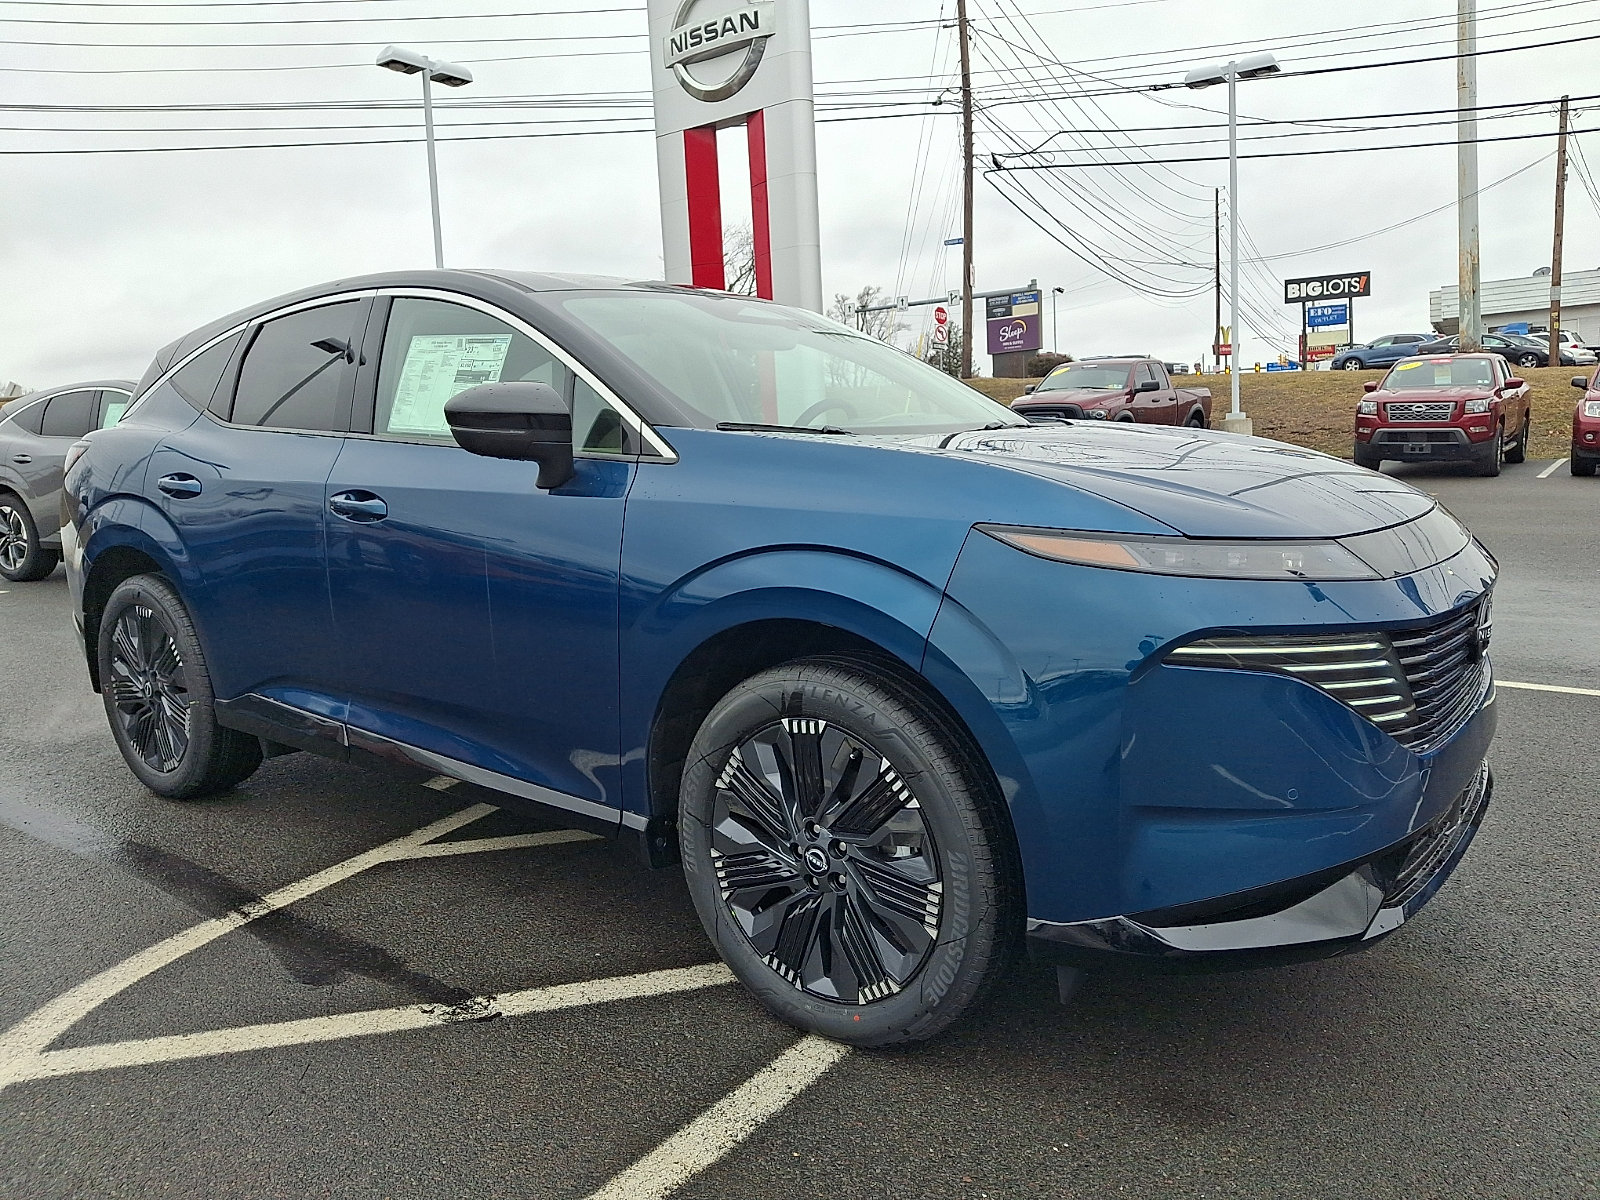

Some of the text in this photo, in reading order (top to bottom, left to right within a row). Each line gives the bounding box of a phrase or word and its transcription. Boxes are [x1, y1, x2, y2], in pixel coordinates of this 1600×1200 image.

[670, 10, 760, 57] NISSAN
[935, 311, 947, 321] STOP
[1309, 307, 1332, 317] EFO
[999, 325, 1023, 342] Sleep
[927, 849, 971, 1008] BRIDGESTONE
